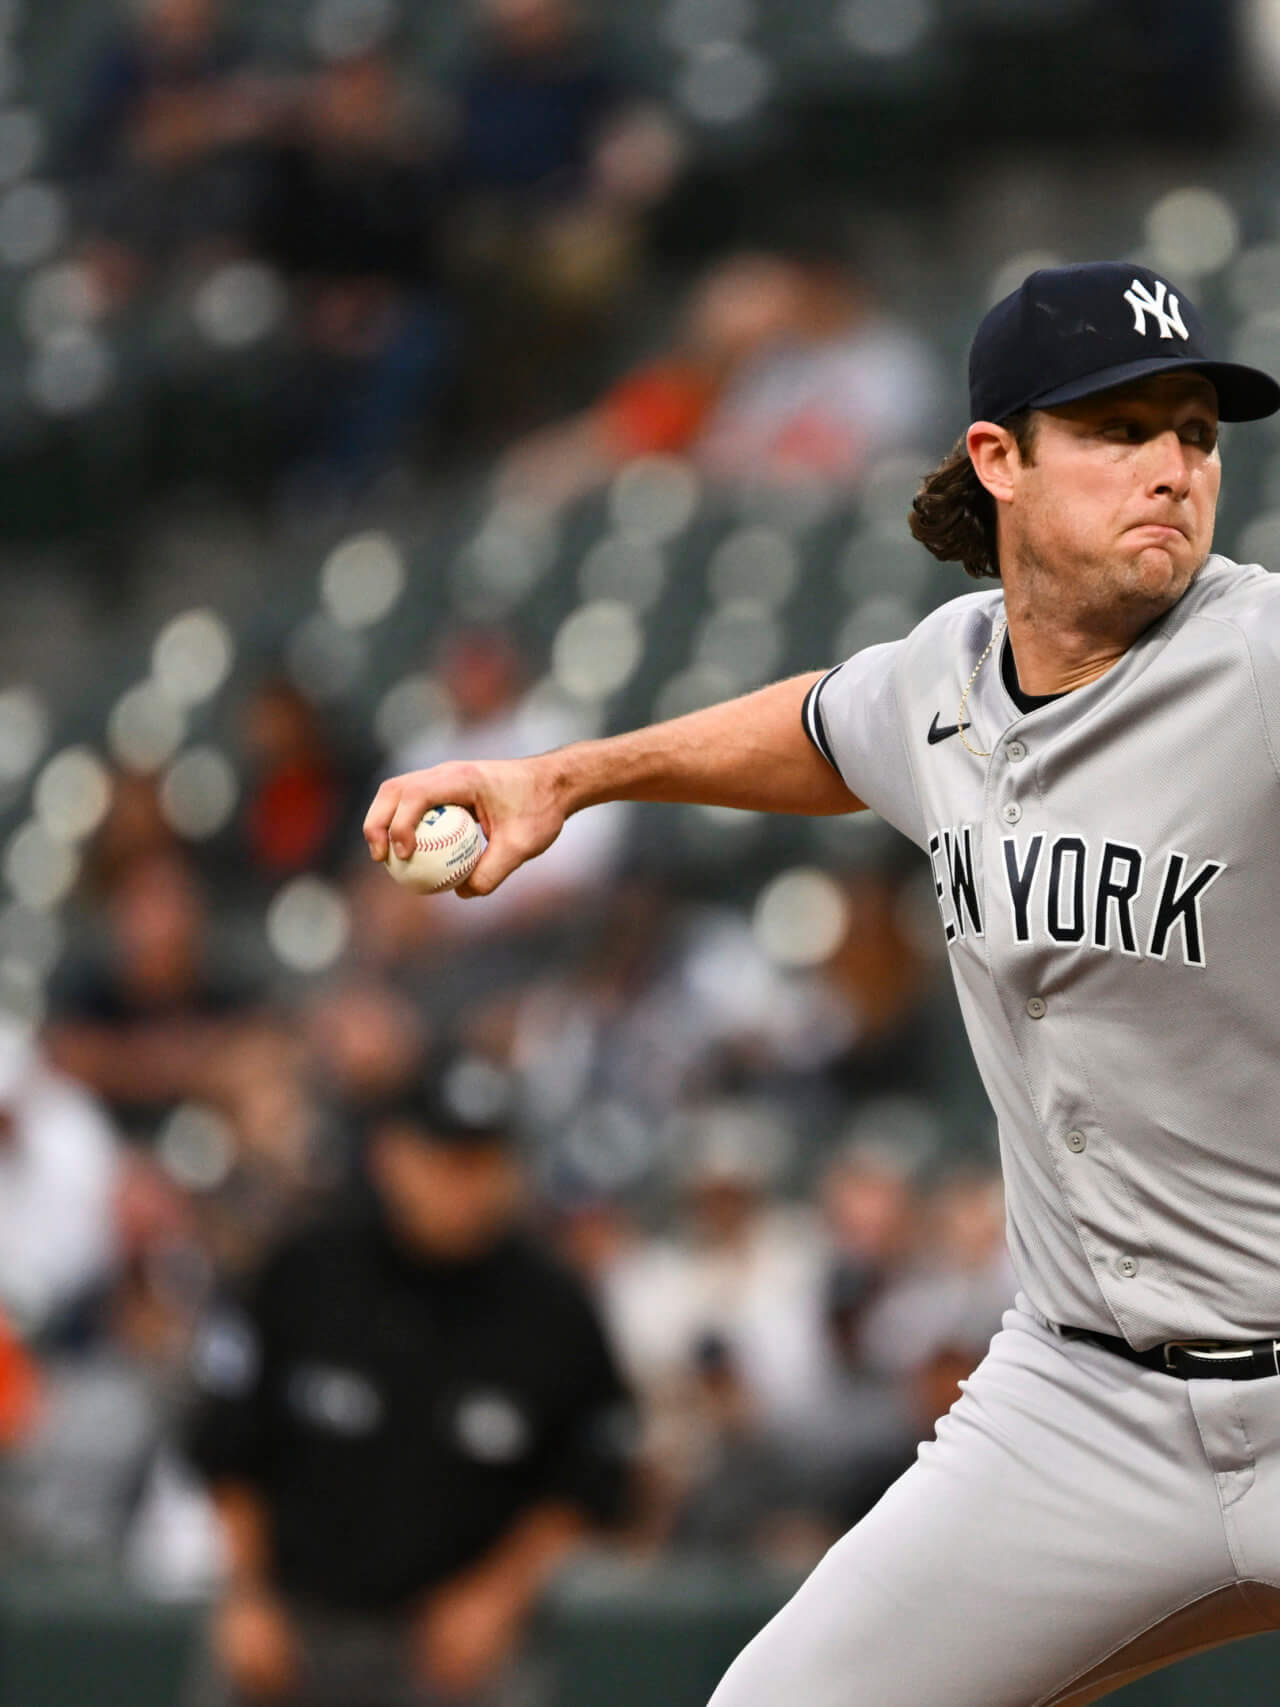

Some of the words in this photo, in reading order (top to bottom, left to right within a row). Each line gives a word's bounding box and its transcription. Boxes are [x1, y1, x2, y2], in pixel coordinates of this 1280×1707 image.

[1123, 279, 1189, 340] NY
[928, 825, 984, 947] EW
[1000, 832, 1228, 967] YORK
